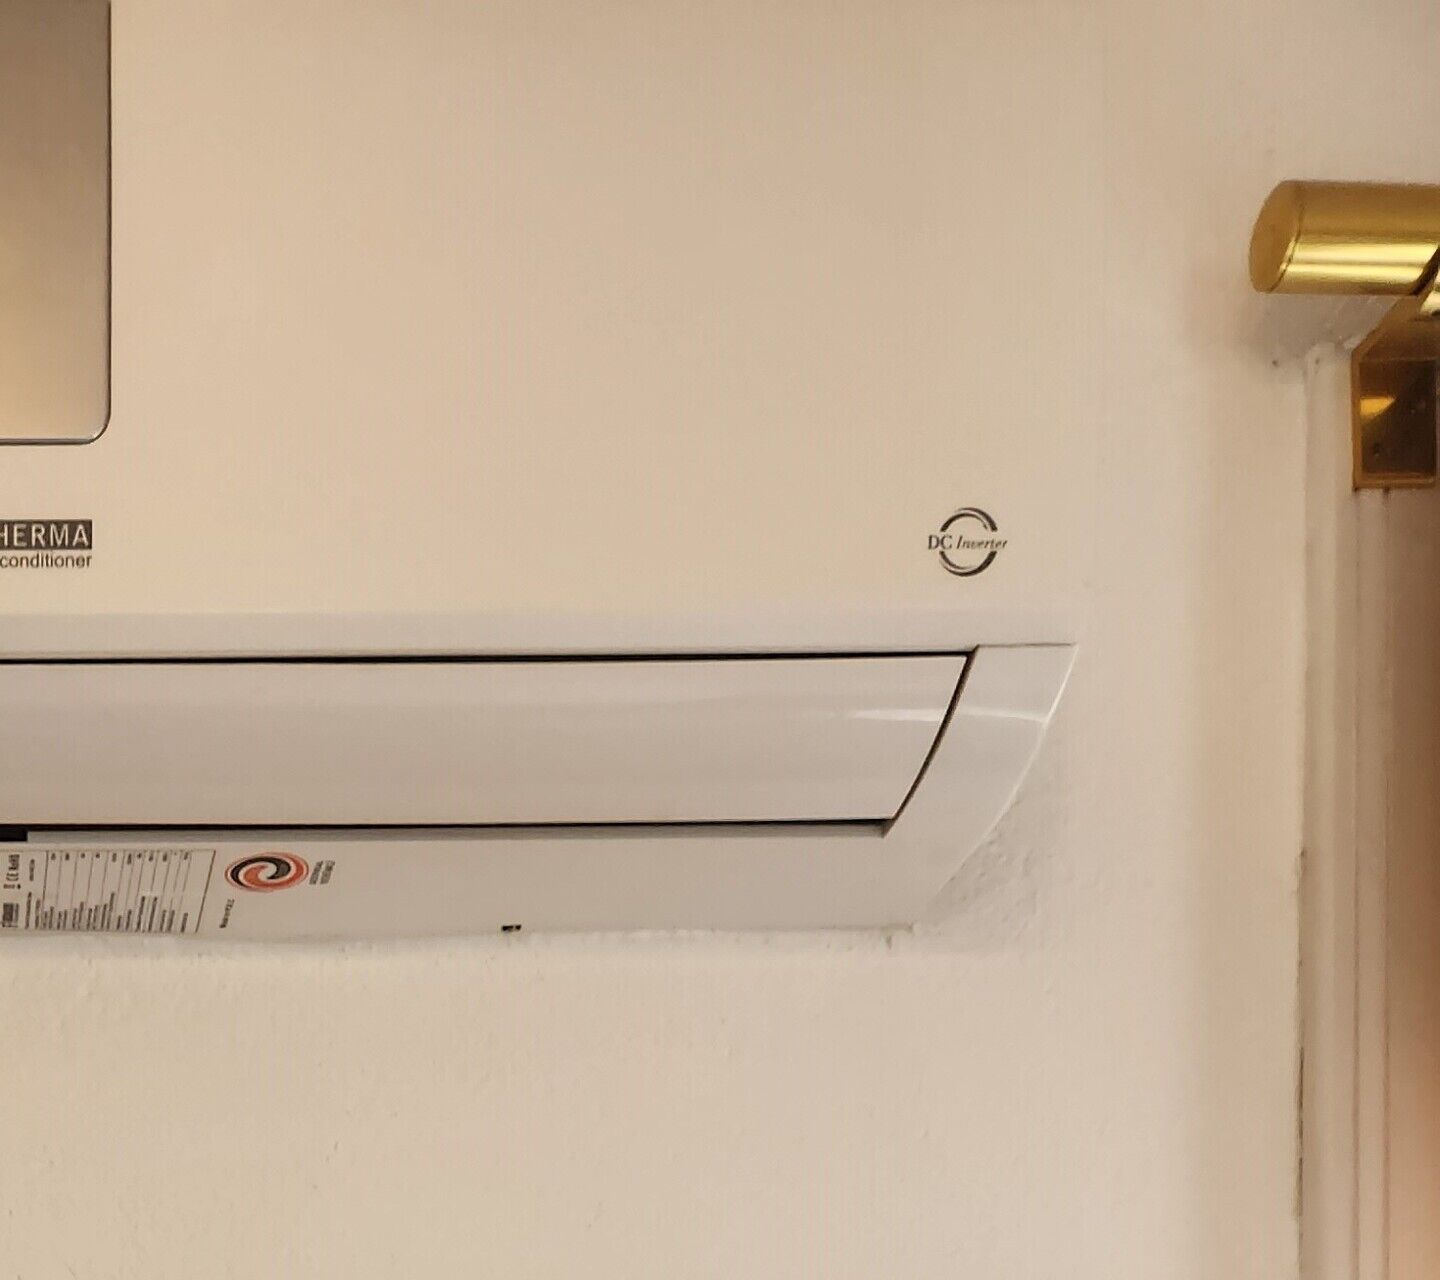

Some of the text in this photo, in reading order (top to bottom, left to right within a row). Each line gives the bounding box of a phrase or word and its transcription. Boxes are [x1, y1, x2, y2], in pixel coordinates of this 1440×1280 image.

[928, 535, 1007, 550] DC Inverter
[0, 551, 92, 568] conditioner
